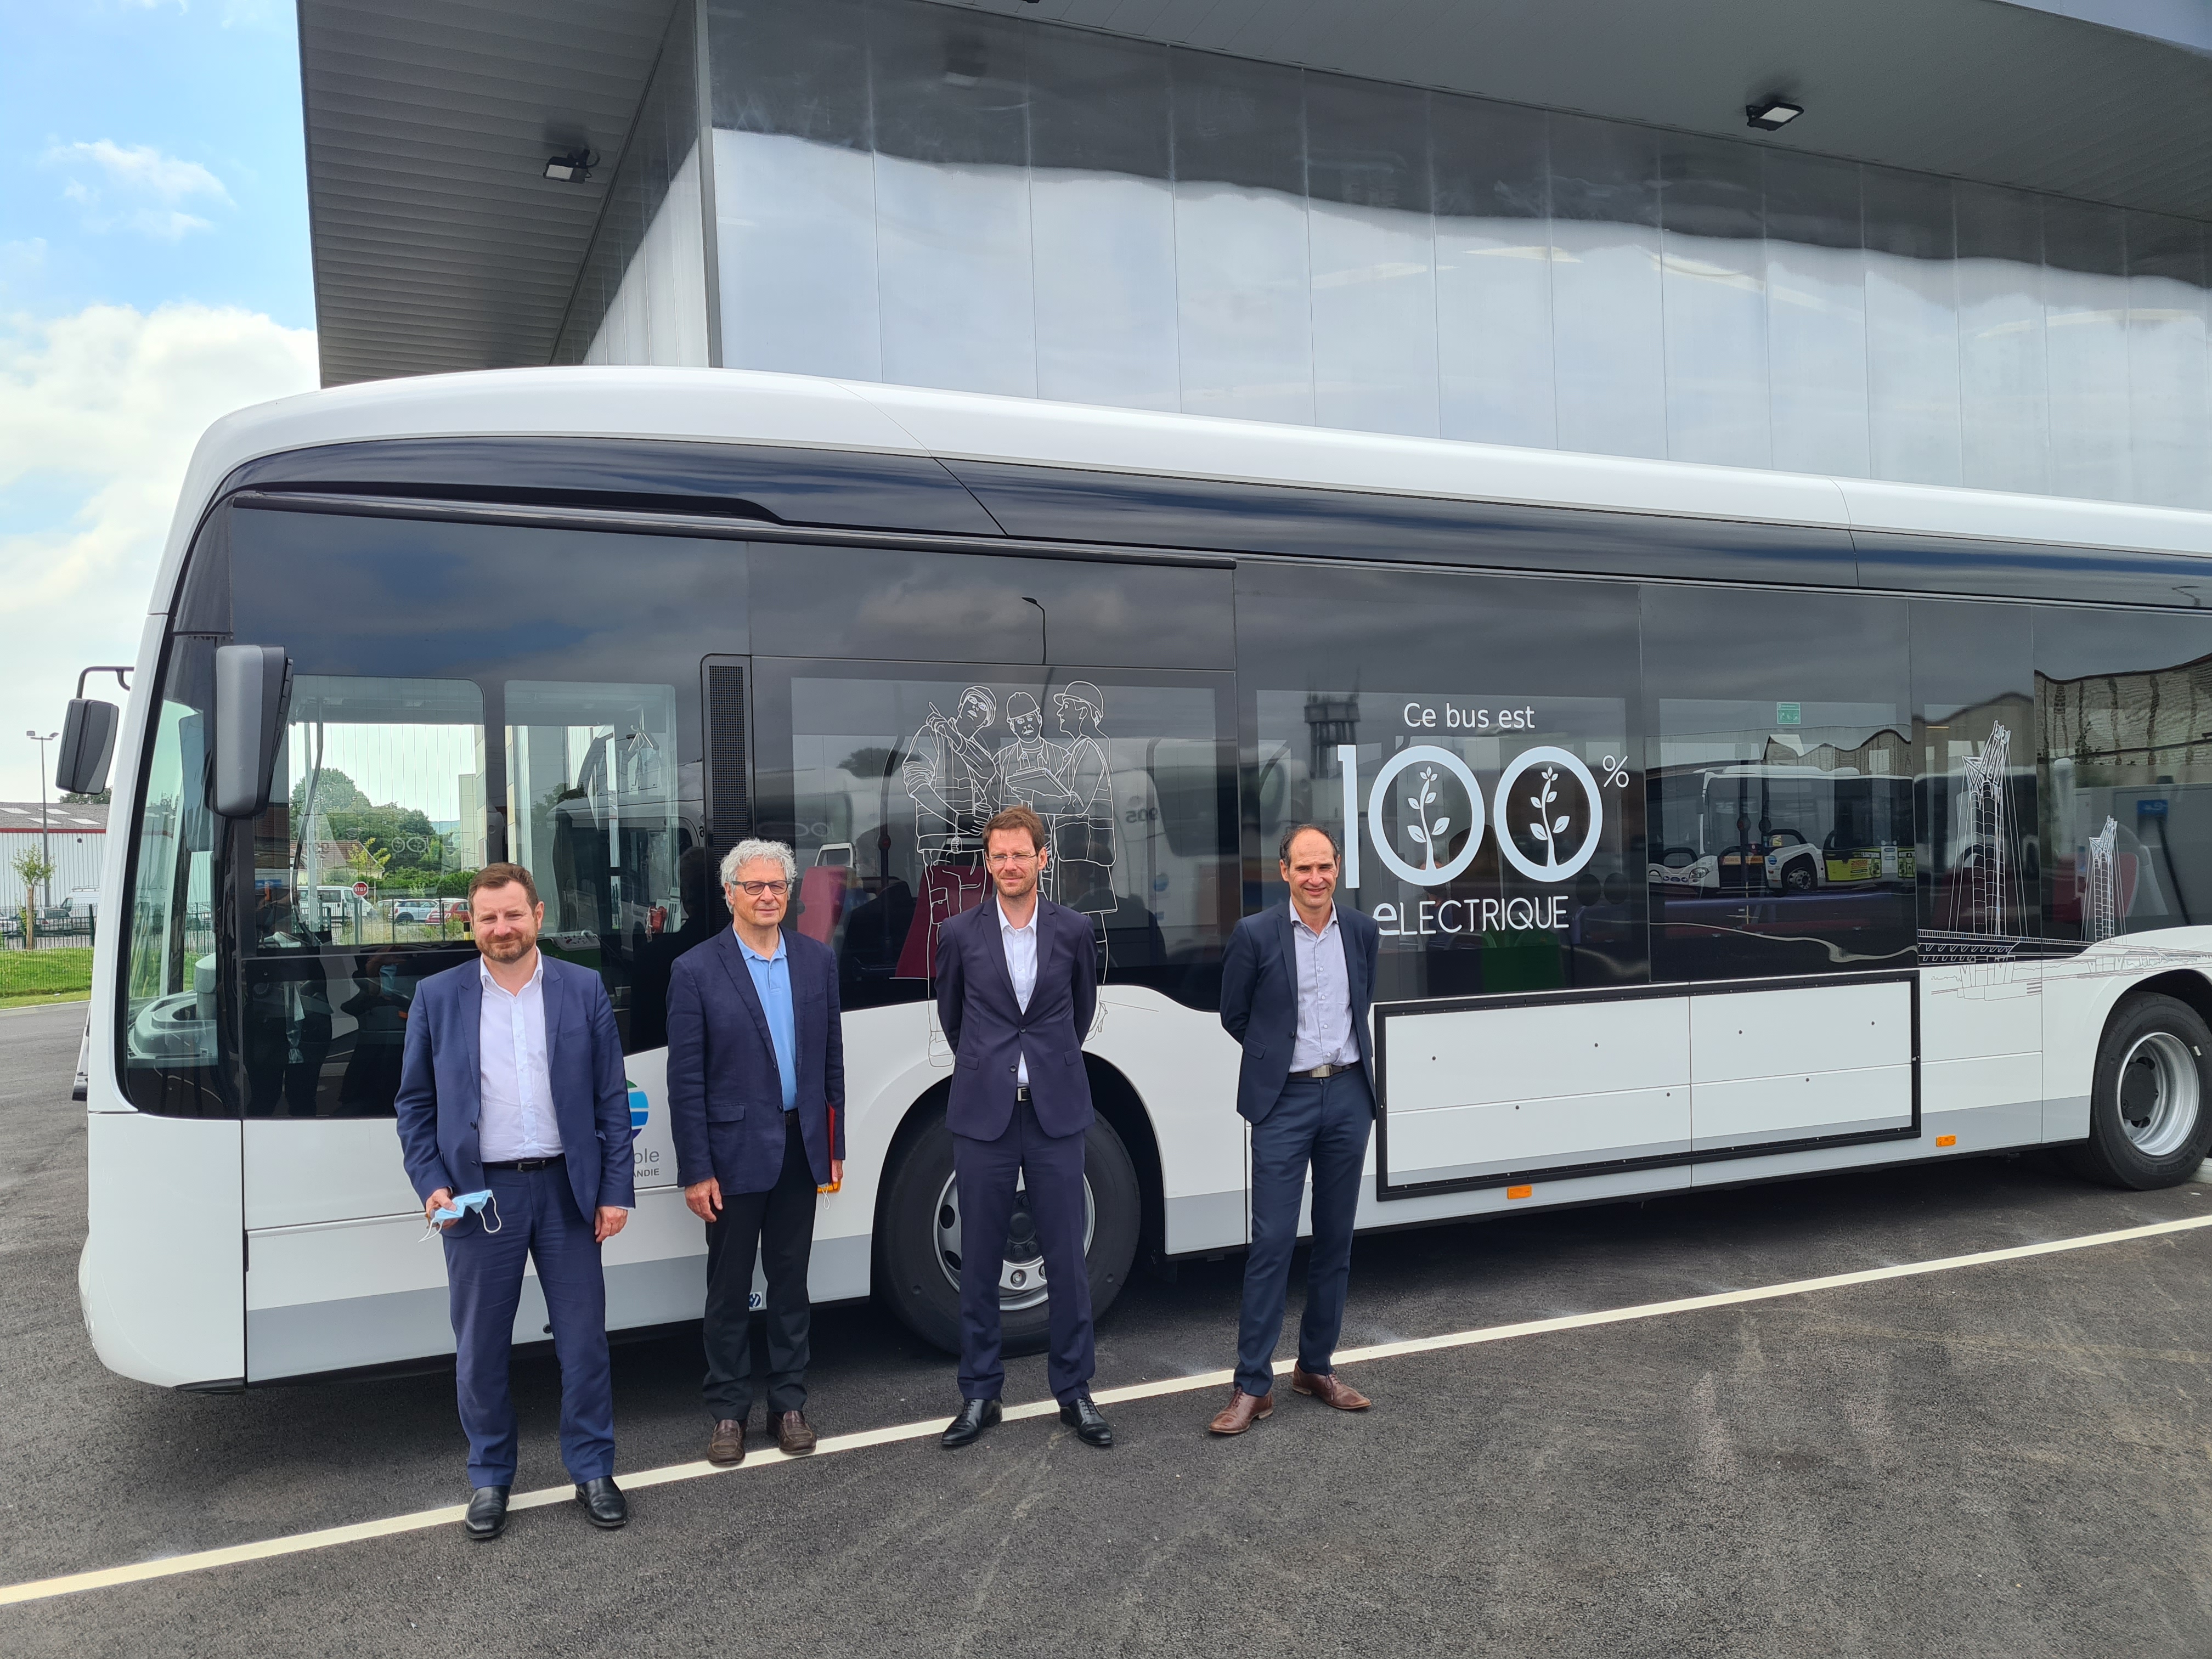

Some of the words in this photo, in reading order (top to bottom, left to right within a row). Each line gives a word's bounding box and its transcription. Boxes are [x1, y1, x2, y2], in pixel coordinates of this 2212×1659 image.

[1403, 702, 1436, 728] Ce
[1446, 702, 1489, 729] bus
[1498, 706, 1536, 729] est
